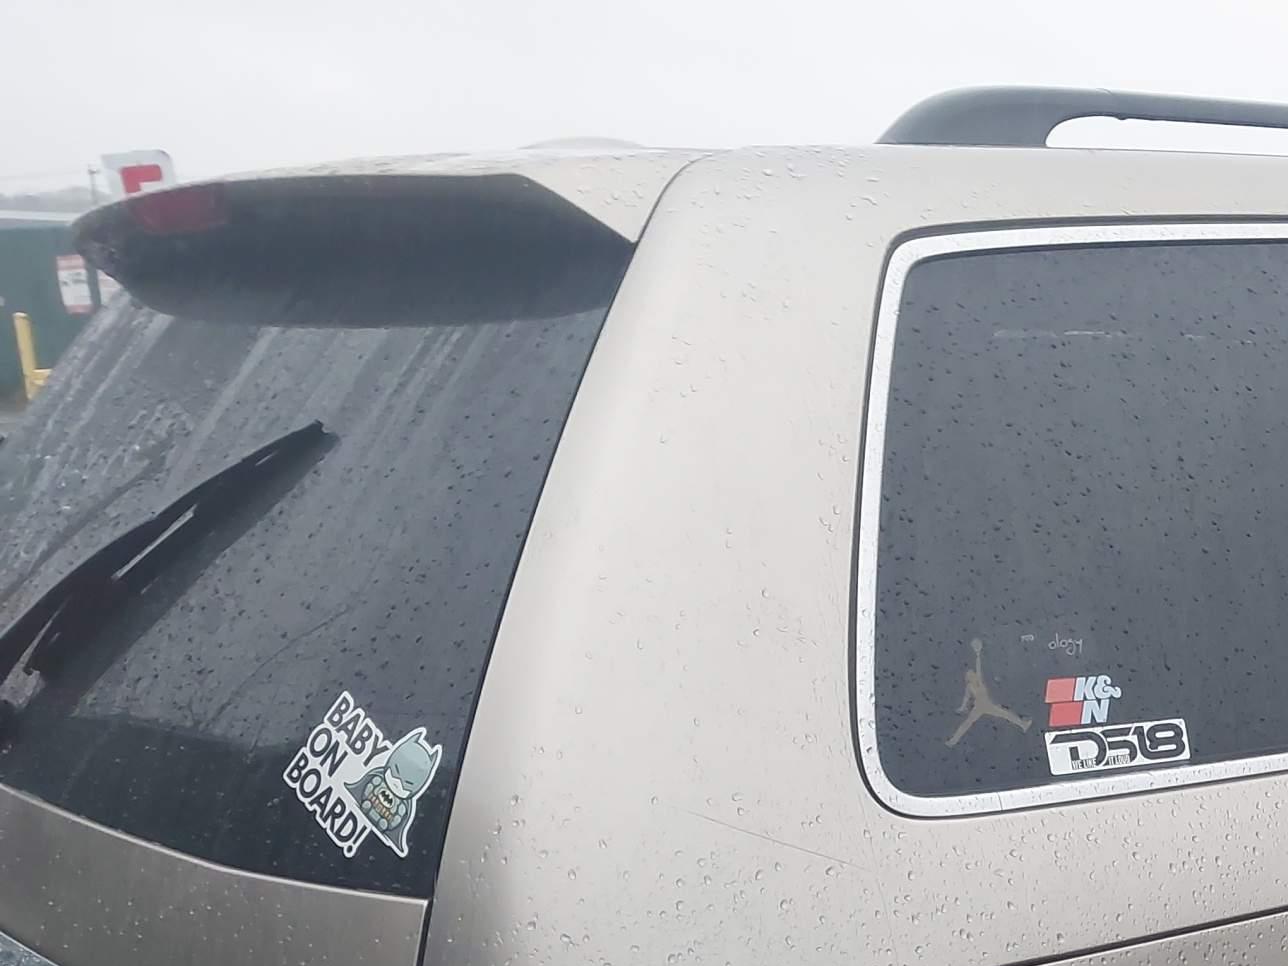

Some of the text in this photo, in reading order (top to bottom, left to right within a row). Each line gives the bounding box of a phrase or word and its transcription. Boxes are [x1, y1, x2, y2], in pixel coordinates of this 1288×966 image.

[309, 727, 349, 778] ON
[327, 697, 390, 766] BABY
[286, 752, 367, 853] BOARD!
